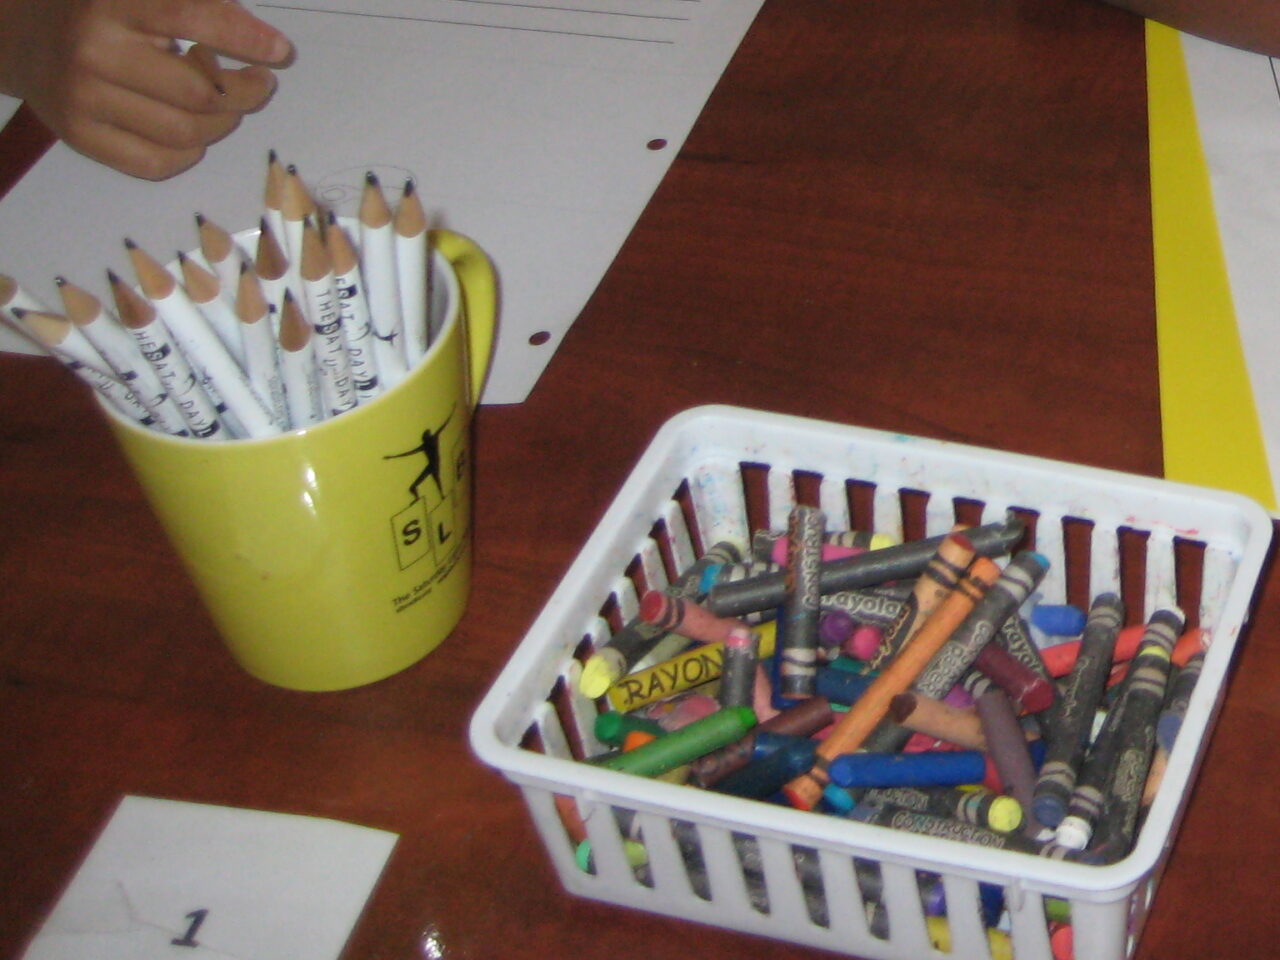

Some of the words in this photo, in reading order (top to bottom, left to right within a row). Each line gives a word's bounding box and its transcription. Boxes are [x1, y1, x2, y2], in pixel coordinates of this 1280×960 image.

[402, 519, 422, 546] S
[821, 591, 901, 619] rayola
[170, 908, 210, 948] 1
